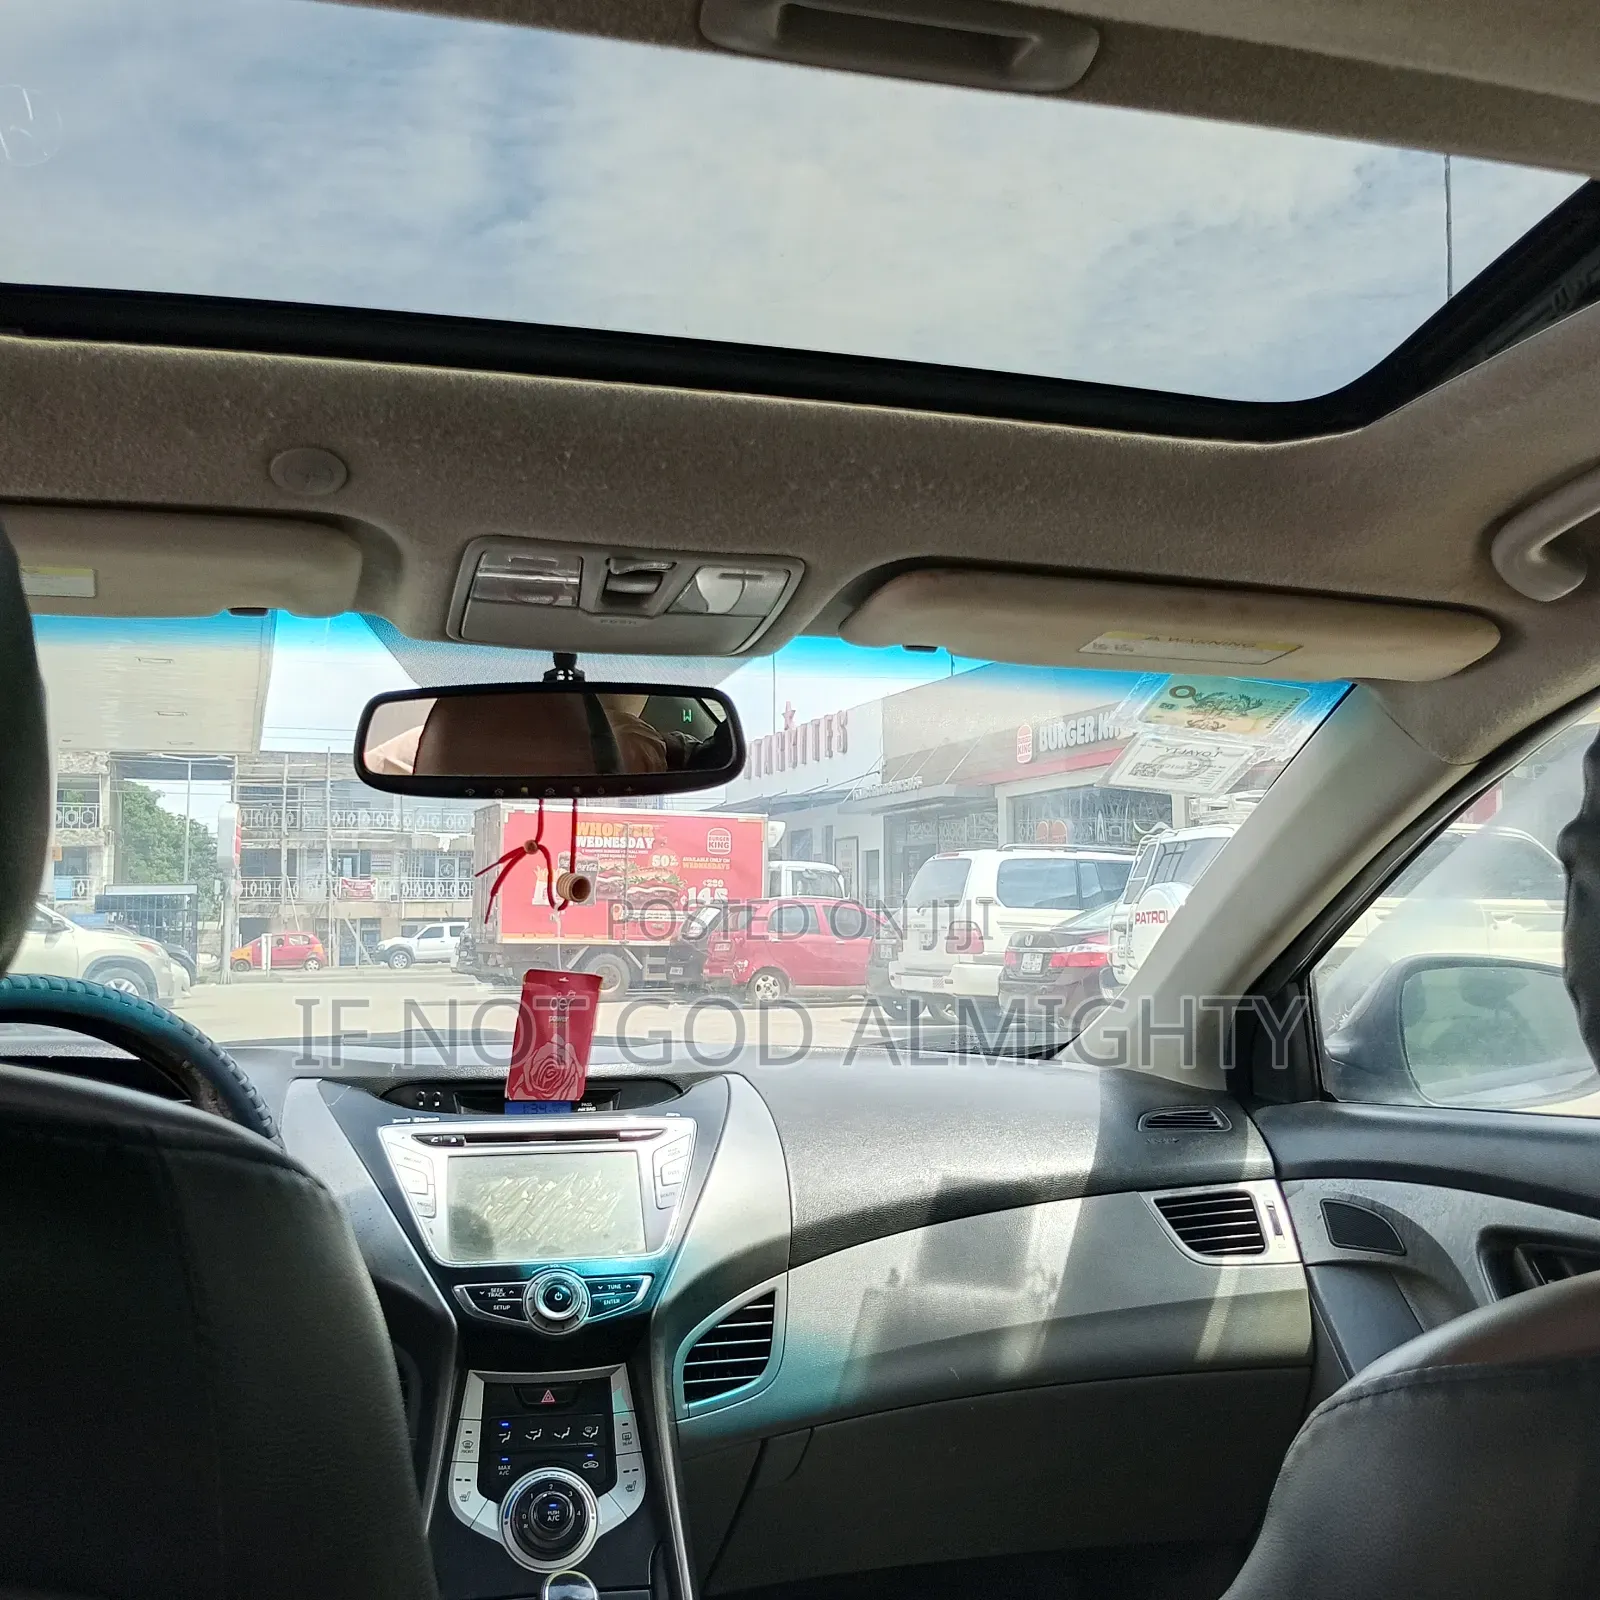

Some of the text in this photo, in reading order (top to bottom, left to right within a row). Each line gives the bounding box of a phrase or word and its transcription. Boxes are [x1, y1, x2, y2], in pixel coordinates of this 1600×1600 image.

[682, 708, 692, 723] W
[1040, 715, 1096, 752] BURGER
[1017, 742, 1032, 755] KING
[576, 836, 655, 849] WEDNESDAY
[708, 841, 730, 849] KING
[651, 854, 679, 868] 50%
